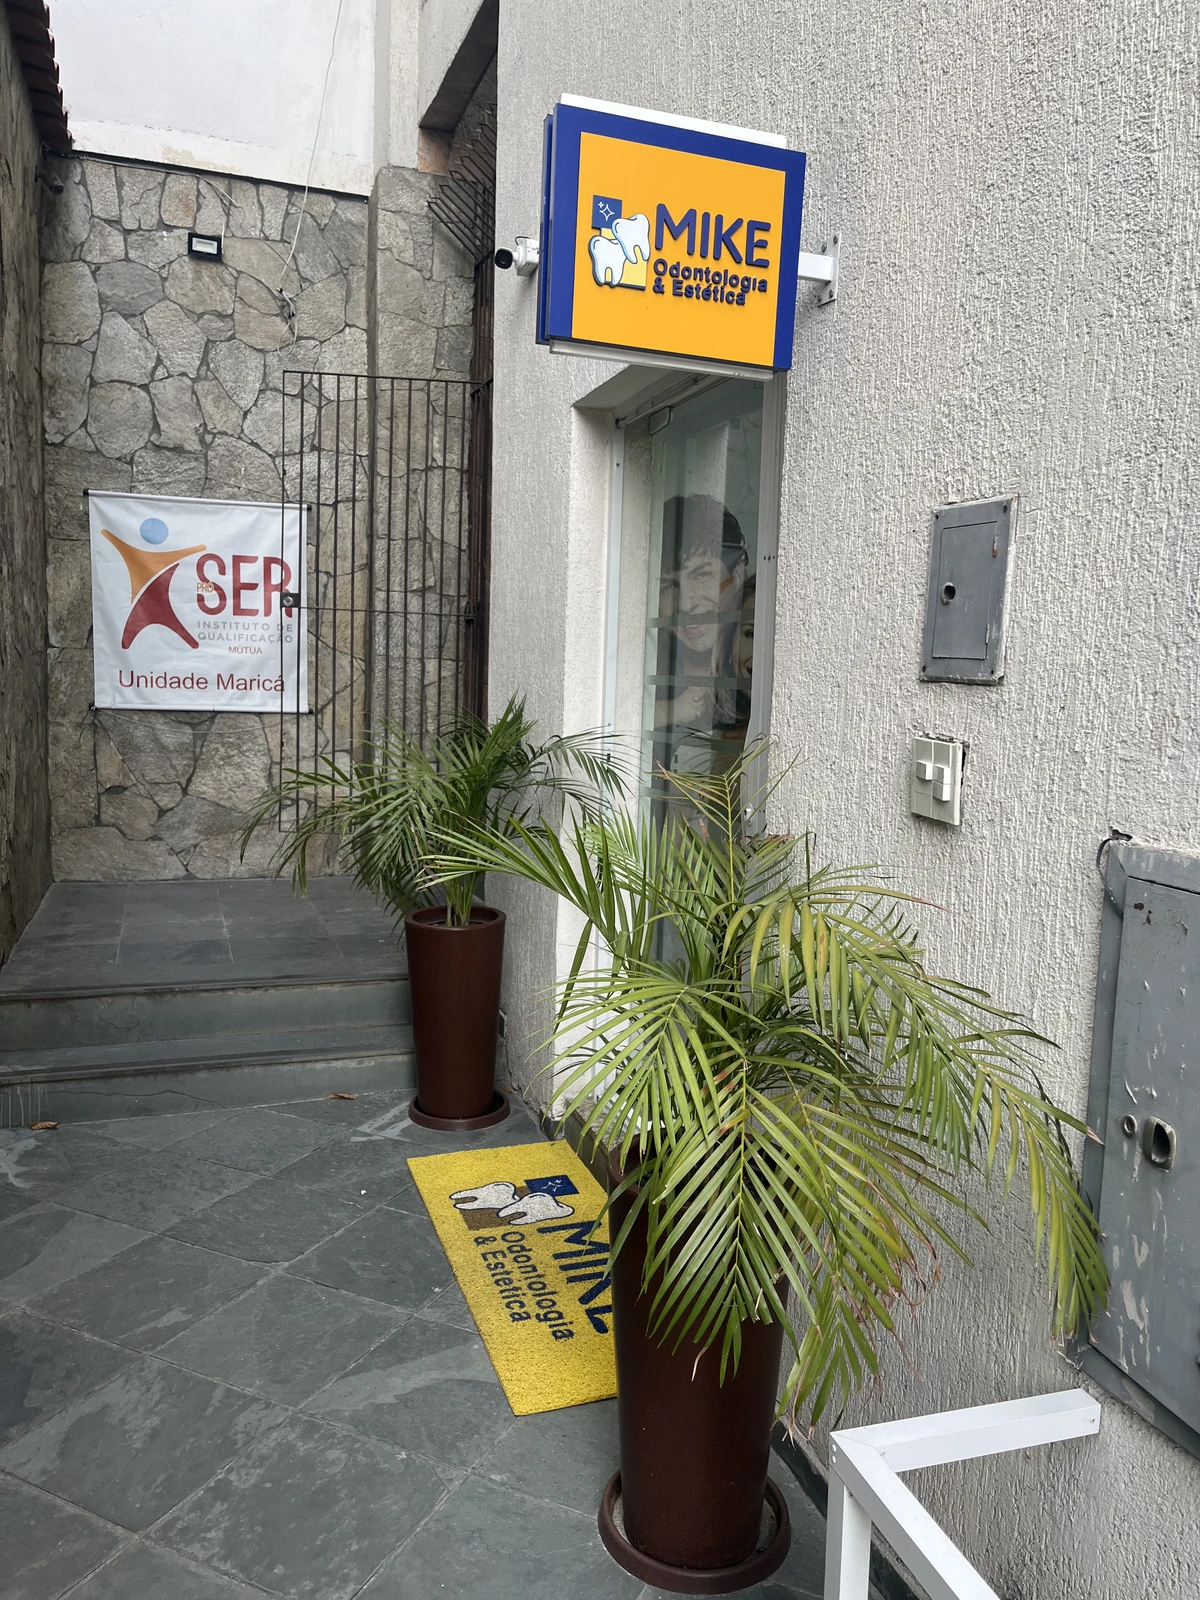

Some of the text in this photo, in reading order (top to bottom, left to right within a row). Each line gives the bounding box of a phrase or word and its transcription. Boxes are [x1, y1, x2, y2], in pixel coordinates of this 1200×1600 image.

[654, 203, 772, 269] MIKE
[653, 258, 768, 293] Odontologia
[653, 277, 746, 306] & Estética
[196, 553, 293, 618] SER
[197, 621, 293, 632] INSTITUTO DE
[228, 645, 263, 655] MÚTUA
[119, 670, 285, 692] Unidade Maricá
[473, 1236, 498, 1247] &
[501, 1231, 575, 1341] Odontologia
